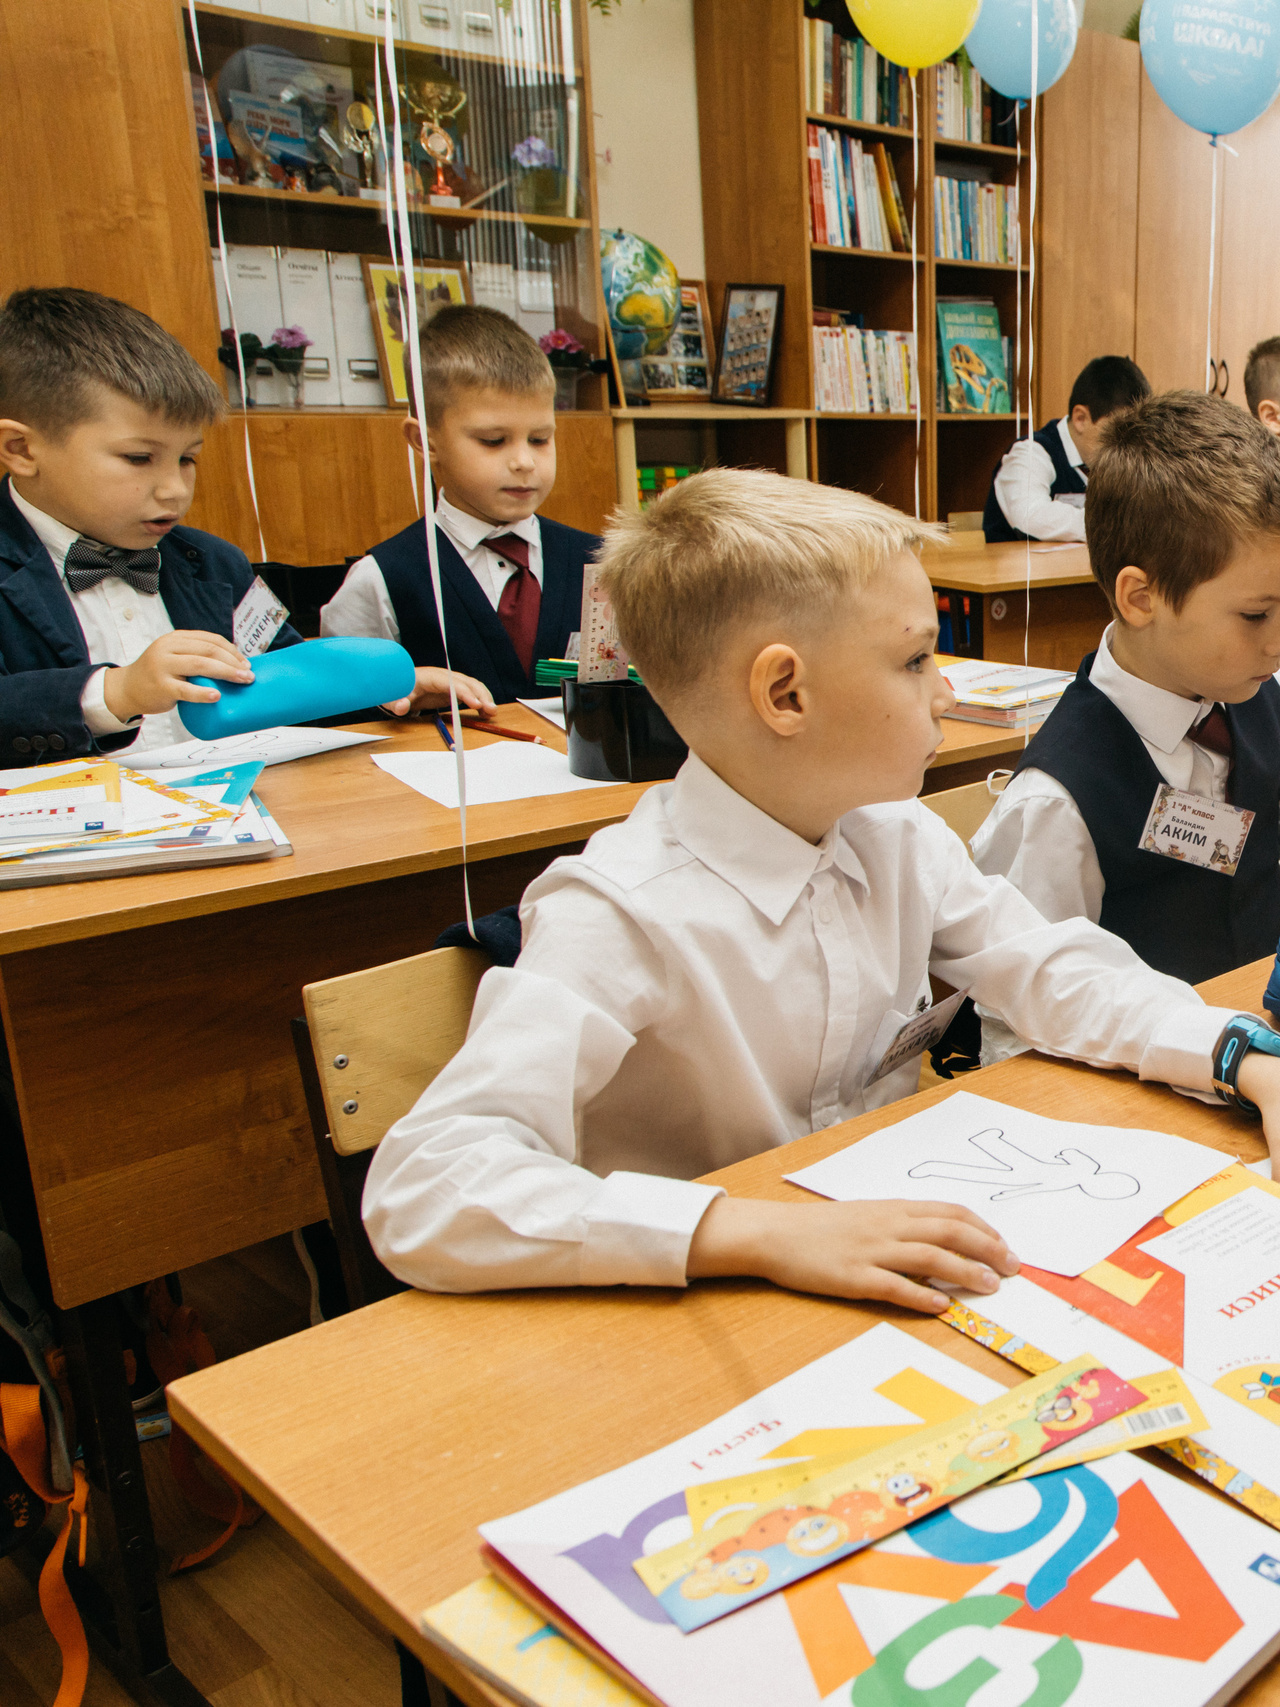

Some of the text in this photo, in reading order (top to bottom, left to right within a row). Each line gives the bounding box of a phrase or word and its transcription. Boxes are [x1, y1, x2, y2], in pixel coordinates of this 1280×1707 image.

[245, 615, 270, 653] СЕМЕН
[1171, 815, 1206, 831] Баландин
[1191, 808, 1215, 821] класс
[1160, 824, 1207, 847] АКИМ
[690, 1418, 782, 1471] Часть 1
